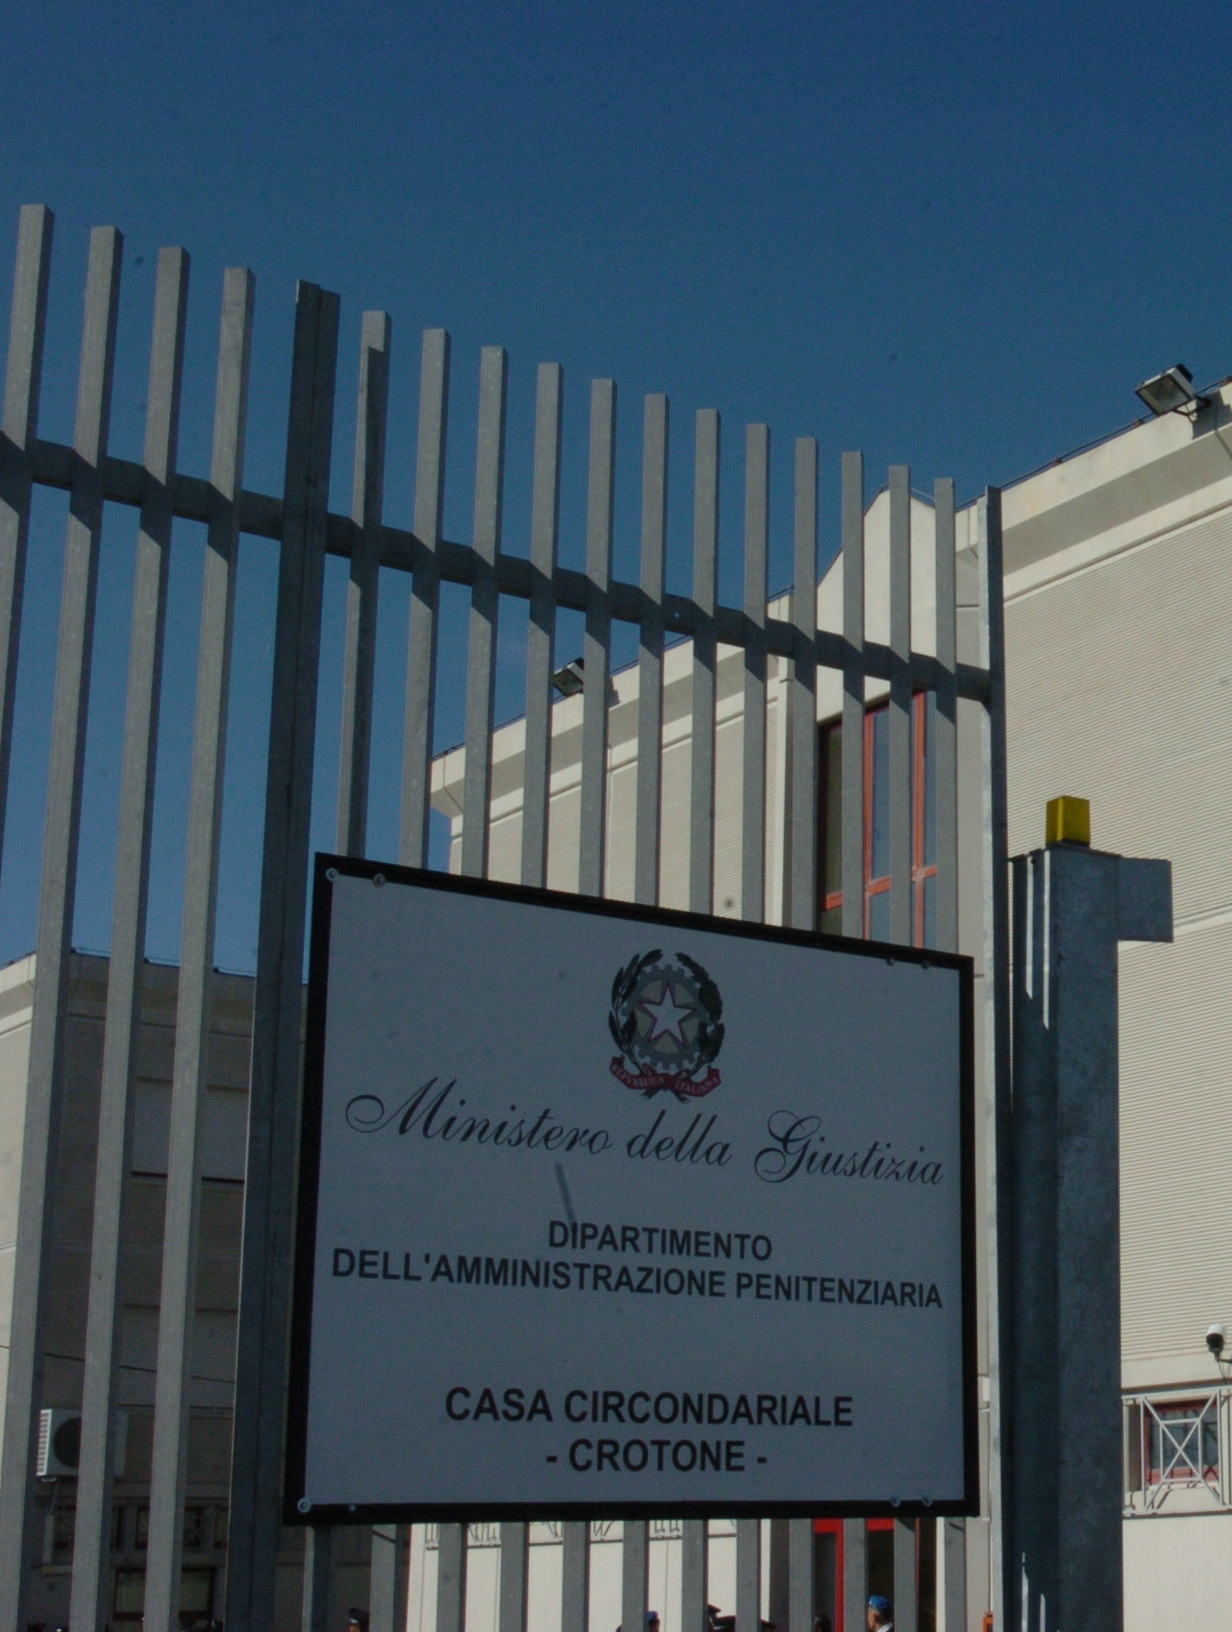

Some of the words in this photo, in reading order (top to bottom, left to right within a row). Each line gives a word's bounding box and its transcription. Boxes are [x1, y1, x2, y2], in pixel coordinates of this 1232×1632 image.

[675, 1076, 720, 1093] ITALIANA
[345, 1076, 613, 1154] Ministero
[625, 1110, 733, 1166] della
[753, 1110, 943, 1185] Giustizia
[548, 1220, 773, 1261] DIPARTIMENTO
[332, 1248, 726, 1297] DELL'AMMINISTRAZIONE
[735, 1275, 943, 1309] PENITENZIARIA
[445, 1386, 553, 1423] CASA
[563, 1389, 854, 1427] CIRCONDARIALE
[568, 1438, 746, 1472] CROTONE
